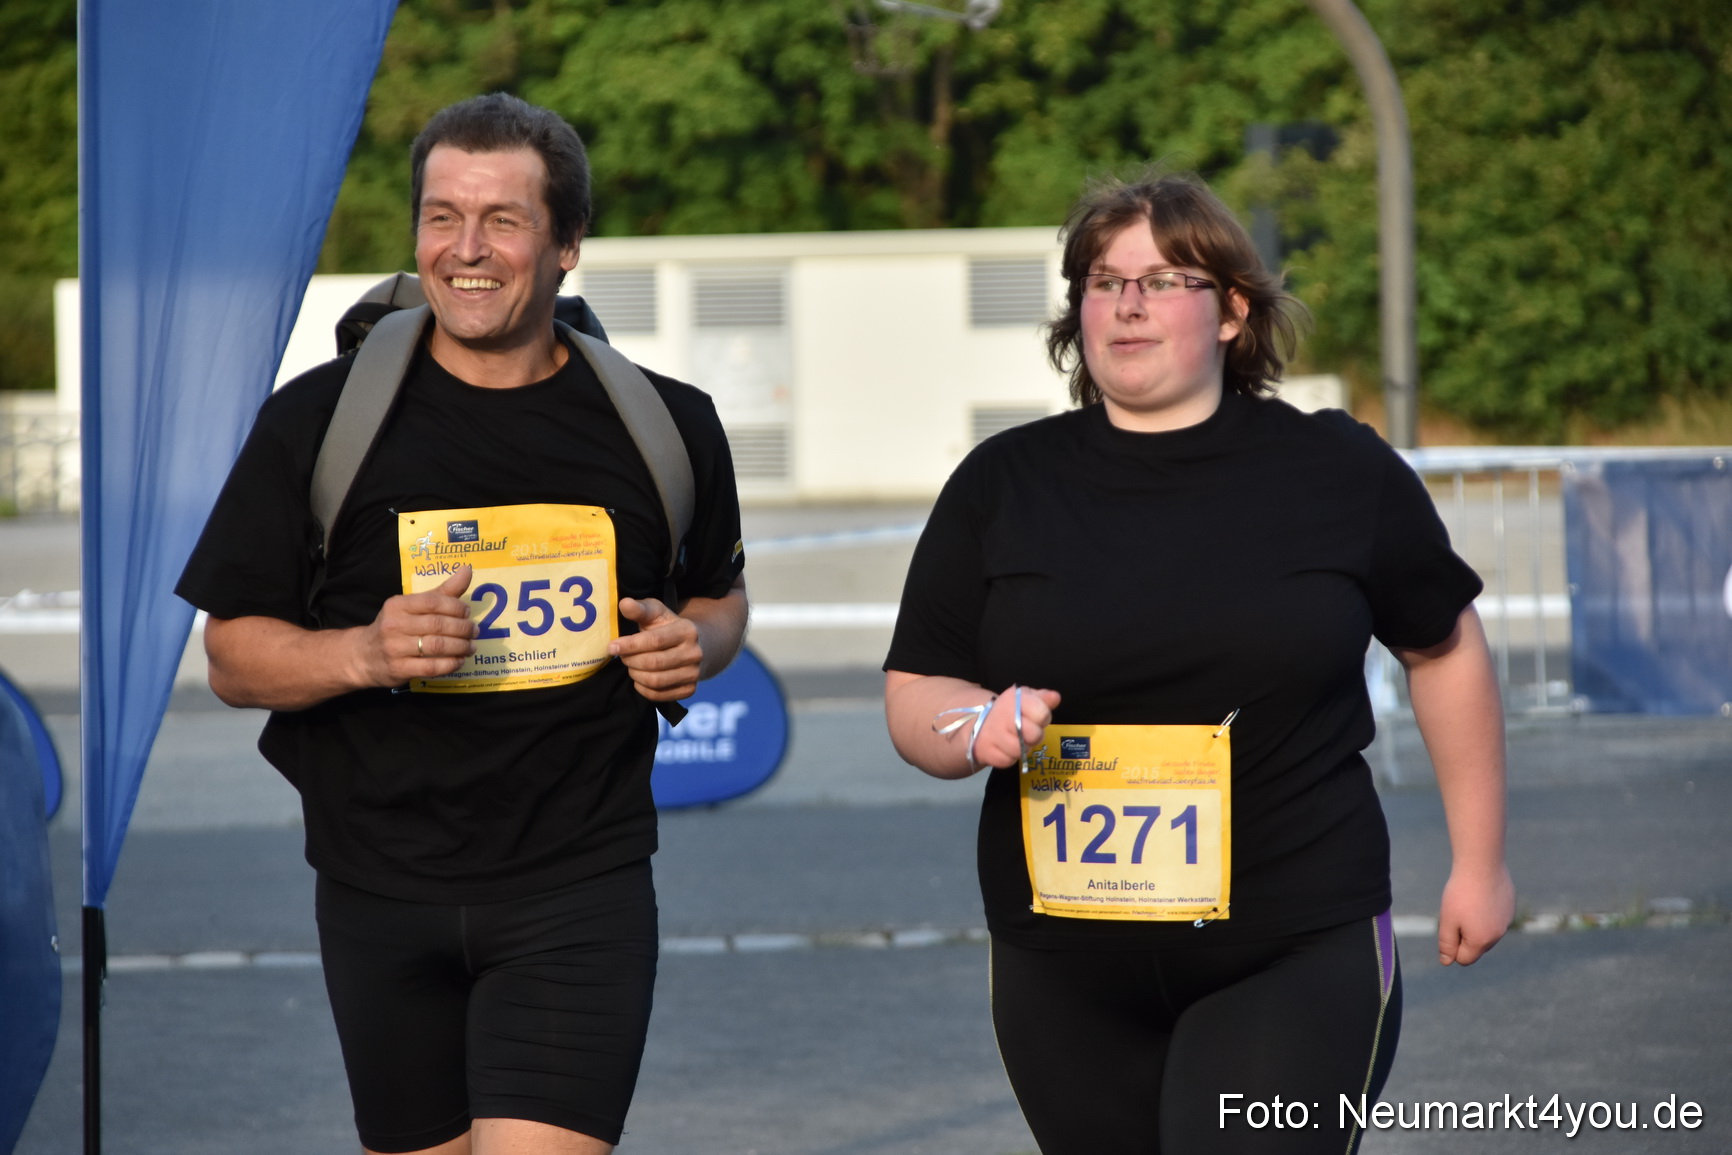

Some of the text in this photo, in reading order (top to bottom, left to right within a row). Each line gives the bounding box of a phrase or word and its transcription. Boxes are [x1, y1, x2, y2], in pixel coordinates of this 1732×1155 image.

[434, 536, 508, 554] firmenlauf
[510, 542, 548, 556] 2015
[434, 552, 468, 560] neumarkt
[470, 575, 597, 641] 253
[474, 648, 558, 665] Hans Schlierf
[500, 666, 533, 675] Holnstein,
[534, 662, 570, 672] Holnsteiner
[570, 656, 606, 668] Werkstätten
[1048, 756, 1120, 771] firmenlauf
[1121, 766, 1160, 780] 2015
[1031, 776, 1084, 792] walken
[1043, 803, 1198, 865] 1271
[1087, 879, 1156, 891] Anita Iberle
[1039, 892, 1217, 904] Regens-Wagner-Stiftung Holnstein, Holnsteiner Werkstätten
